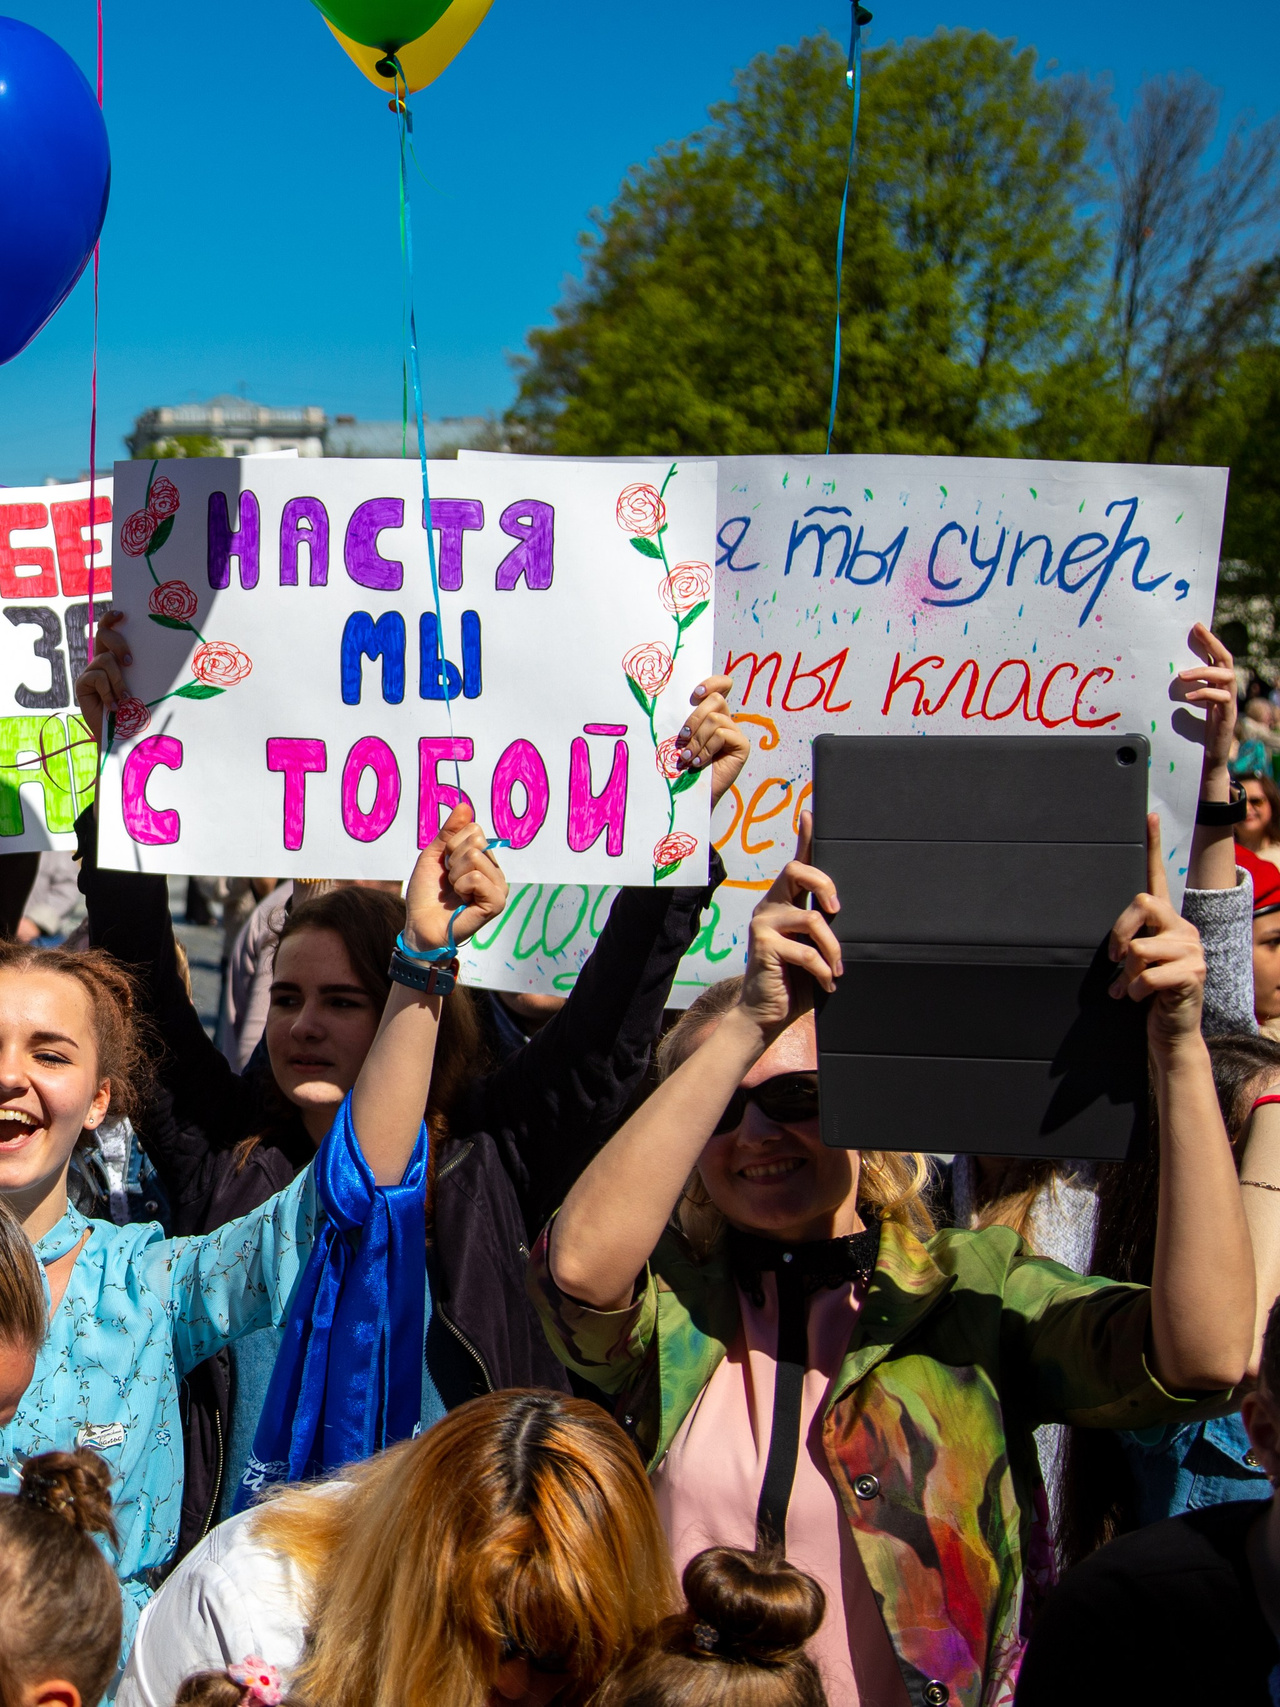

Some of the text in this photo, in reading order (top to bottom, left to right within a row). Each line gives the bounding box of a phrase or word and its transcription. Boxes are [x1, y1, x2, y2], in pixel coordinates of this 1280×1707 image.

[207, 489, 555, 592] НАСТЯ
[784, 506, 909, 587] ты
[341, 610, 482, 704] МЫ
[724, 648, 1121, 728] ты класс
[122, 723, 628, 857] С ТОБОЙ
